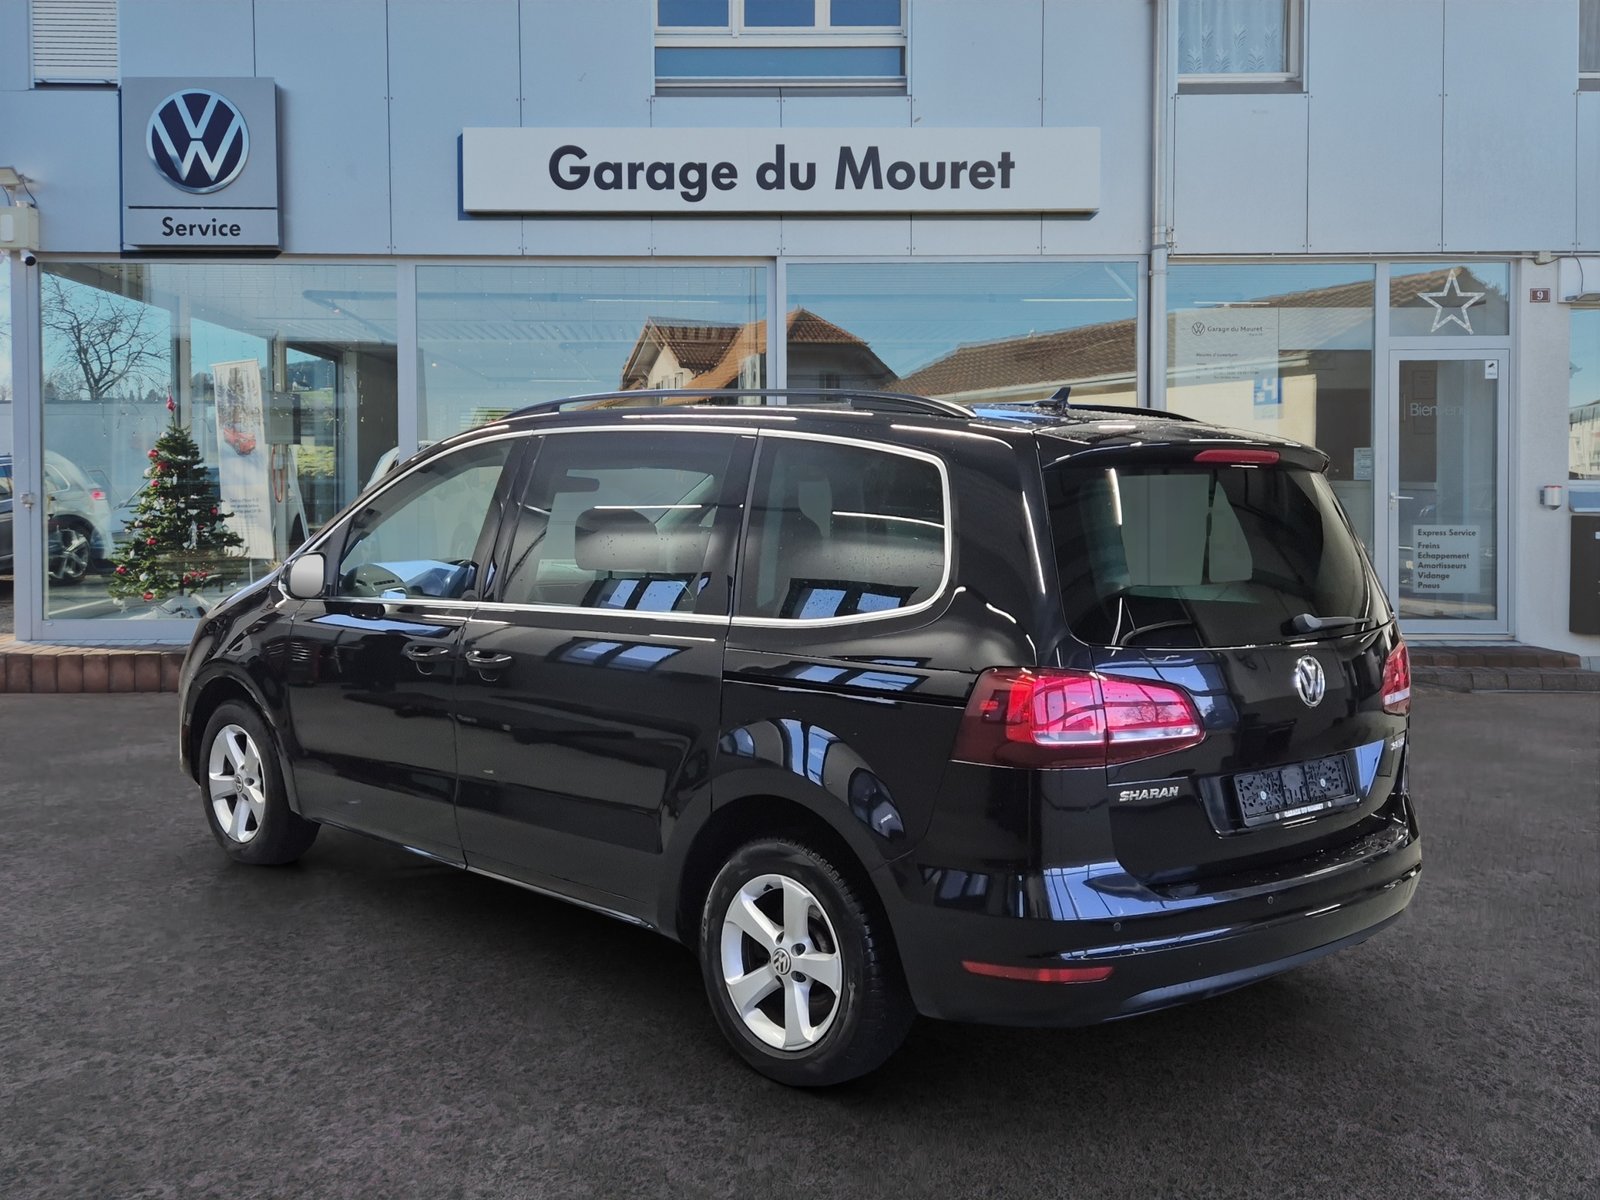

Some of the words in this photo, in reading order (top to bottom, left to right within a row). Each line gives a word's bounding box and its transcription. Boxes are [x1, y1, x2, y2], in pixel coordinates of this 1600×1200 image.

[548, 144, 738, 203] Garage
[755, 143, 817, 191] du
[834, 145, 1016, 191] Mouret
[161, 216, 242, 237] Service
[1536, 291, 1544, 300] 9
[1207, 325, 1230, 334] Garage
[1417, 528, 1447, 537] Express
[1448, 528, 1477, 536] Service
[1417, 541, 1441, 549] Freins
[1417, 551, 1470, 560] Echappement
[1417, 561, 1467, 569] Amortisseurs
[1417, 571, 1450, 581] Vidange
[1417, 581, 1440, 589] Pneus
[1119, 786, 1179, 802] SHARAN
